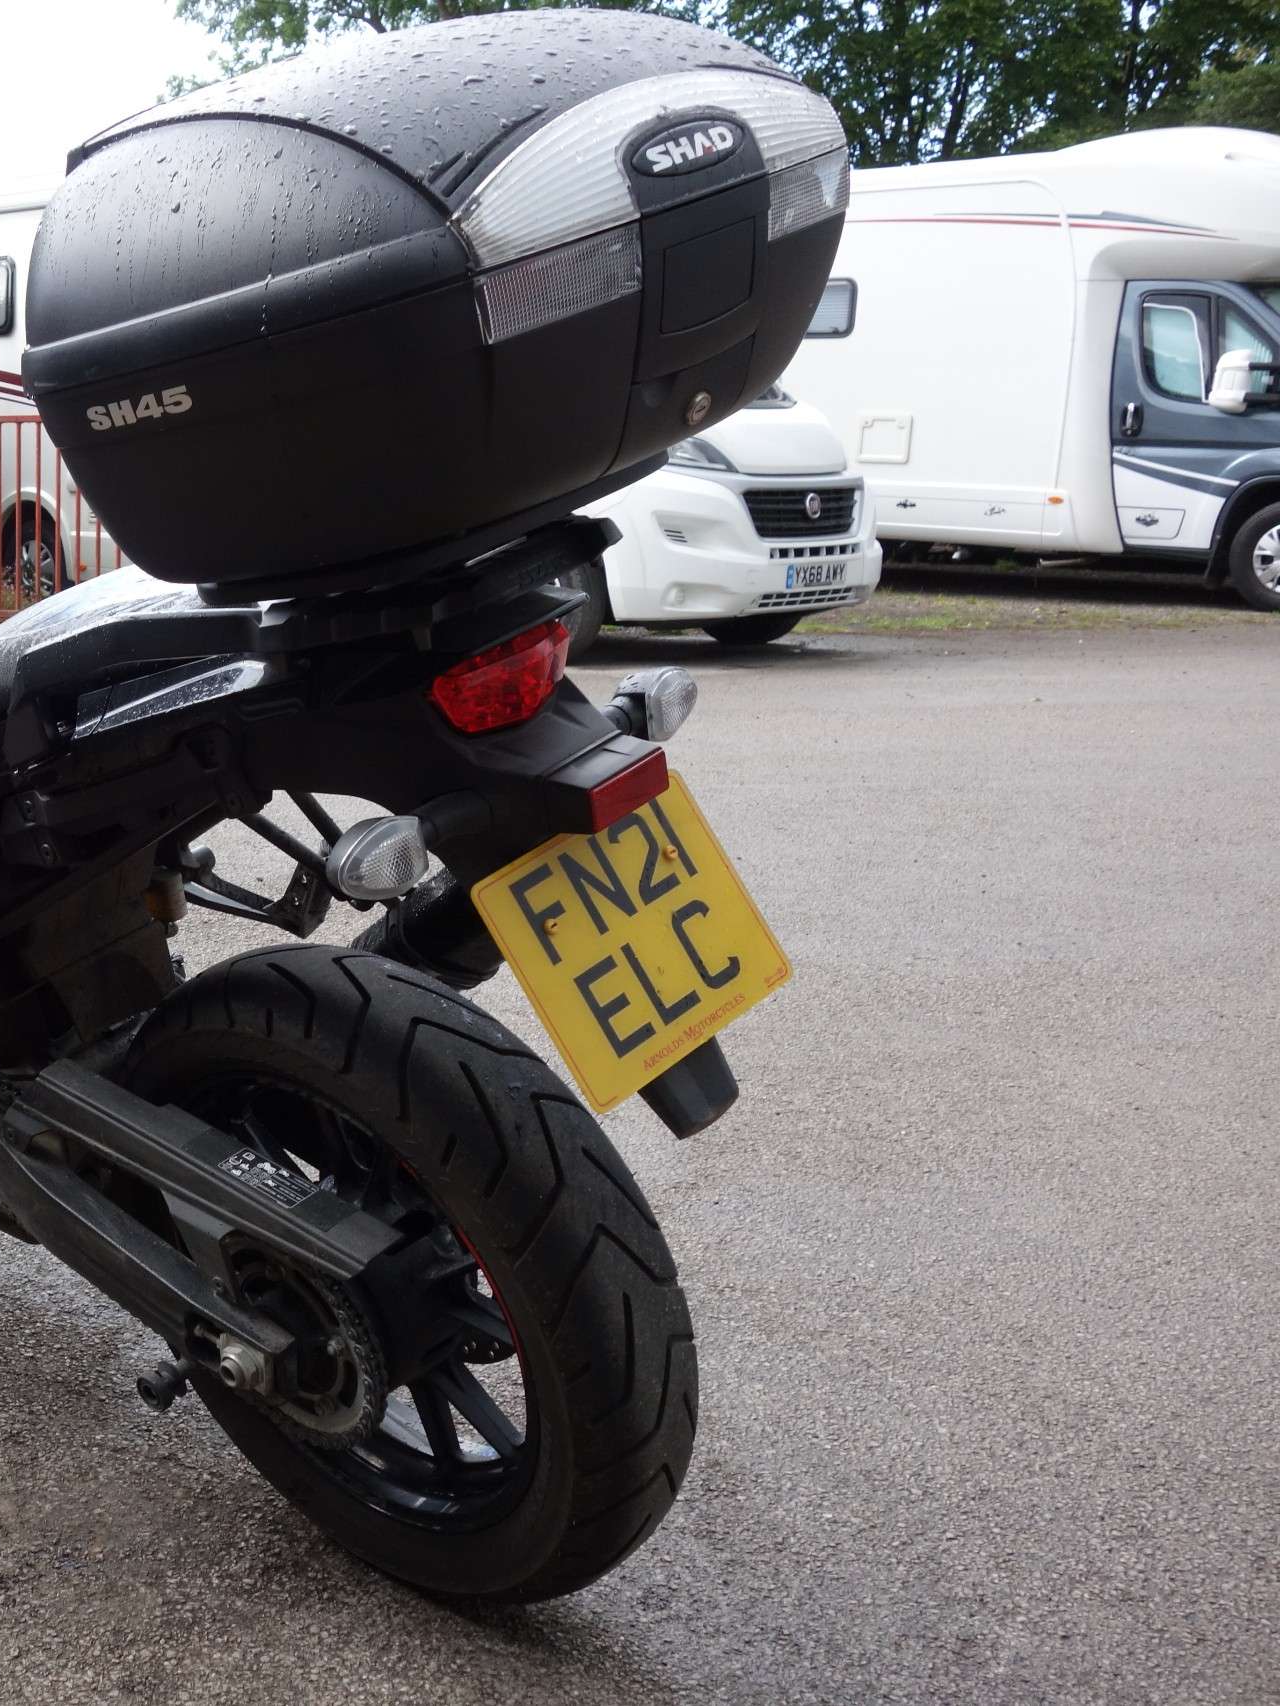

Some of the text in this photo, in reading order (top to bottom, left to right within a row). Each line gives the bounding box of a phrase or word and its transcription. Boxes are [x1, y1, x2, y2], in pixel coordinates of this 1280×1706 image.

[645, 126, 734, 173] SHAD
[86, 384, 193, 431] SH45
[508, 798, 699, 966] FN21
[573, 899, 741, 1059] ELC
[643, 1035, 686, 1072] ARNOLDS
